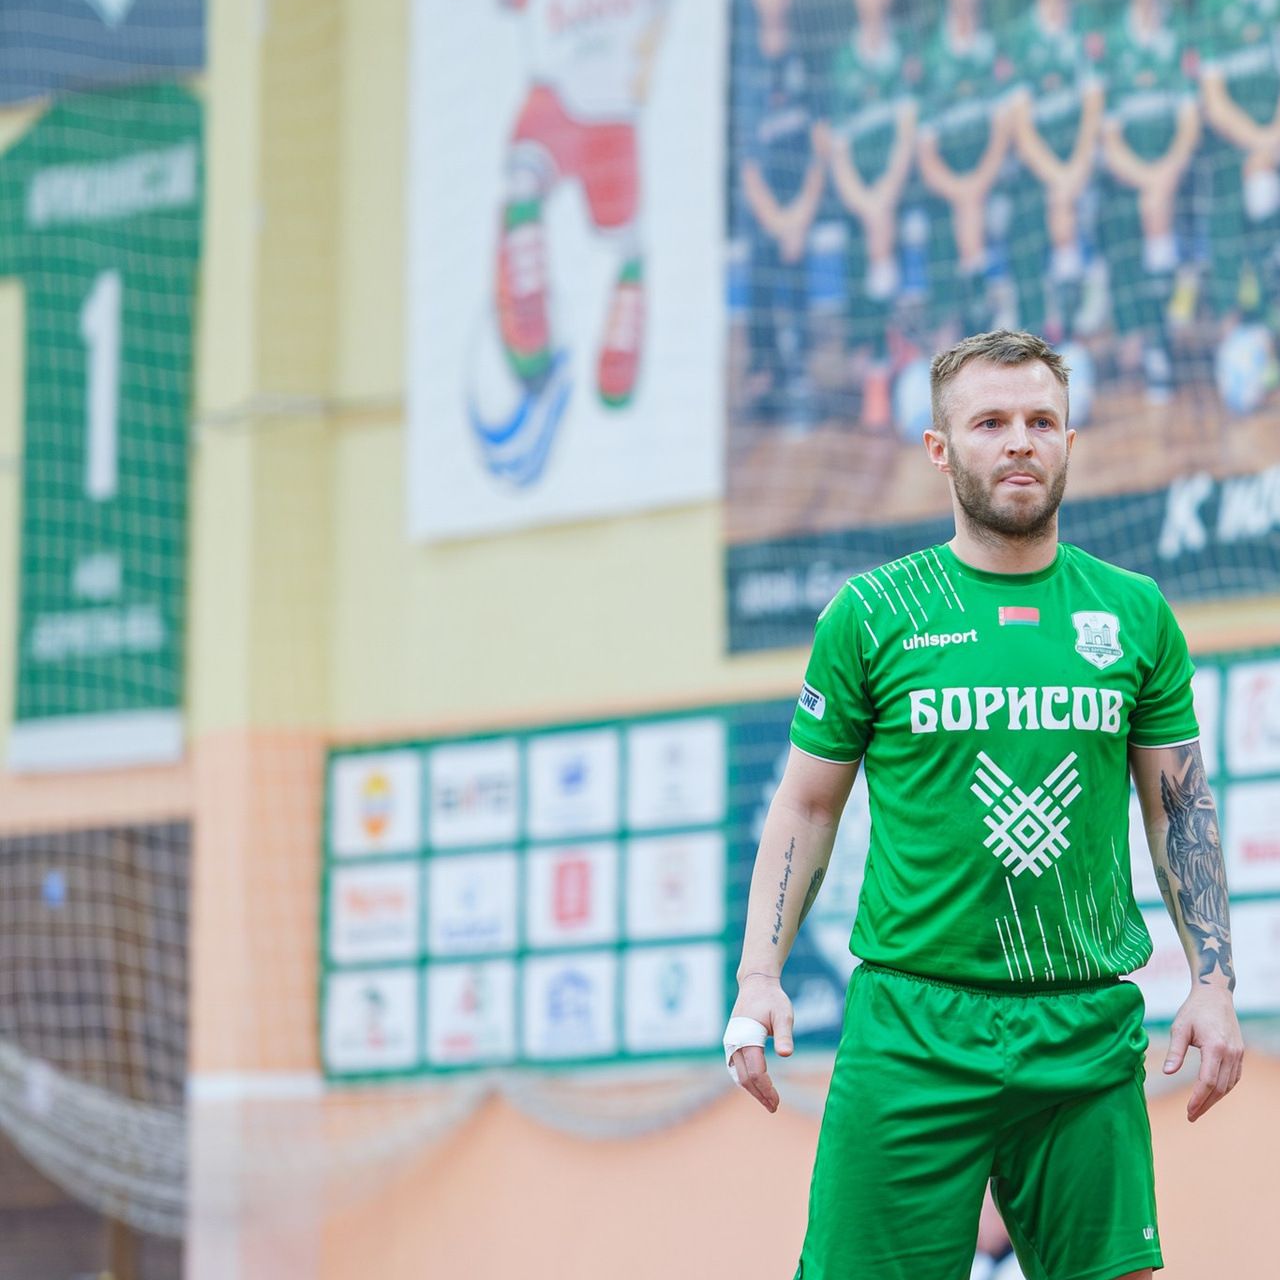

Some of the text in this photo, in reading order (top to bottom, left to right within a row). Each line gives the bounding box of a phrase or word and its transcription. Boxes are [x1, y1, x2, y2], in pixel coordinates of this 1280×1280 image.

[79, 269, 122, 501] 1
[903, 629, 978, 650] uhlsport
[909, 686, 1124, 734] БОРИСОВ
